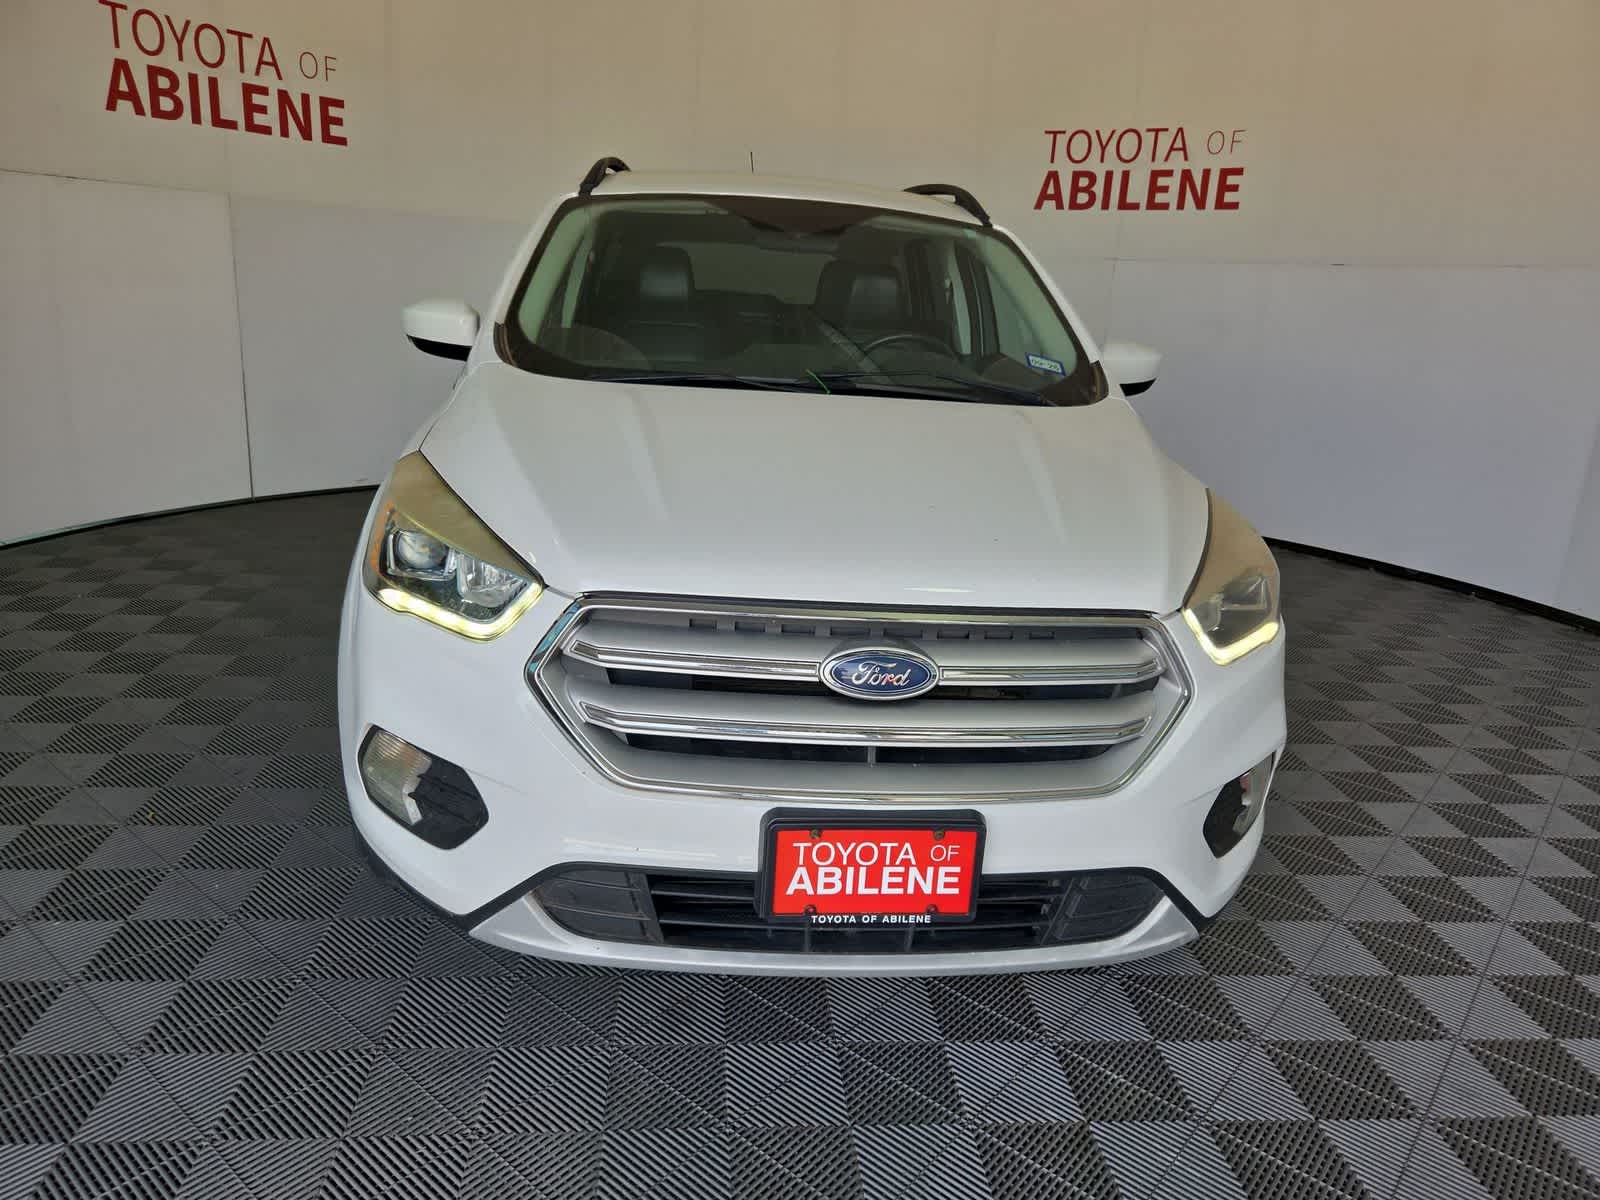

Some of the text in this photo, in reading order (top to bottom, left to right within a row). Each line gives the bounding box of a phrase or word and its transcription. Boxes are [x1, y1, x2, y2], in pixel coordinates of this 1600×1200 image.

[98, 0, 337, 81] TOYOTA OF
[105, 57, 348, 147] ABILENE
[1044, 127, 1246, 164] TOYOTA OF
[1033, 167, 1245, 211] ABILENE
[851, 660, 912, 686] Ford
[792, 842, 961, 866] TOYOTA OF
[785, 866, 961, 896] ABILENE
[811, 914, 932, 924] TOYOTA OF ABILENE
